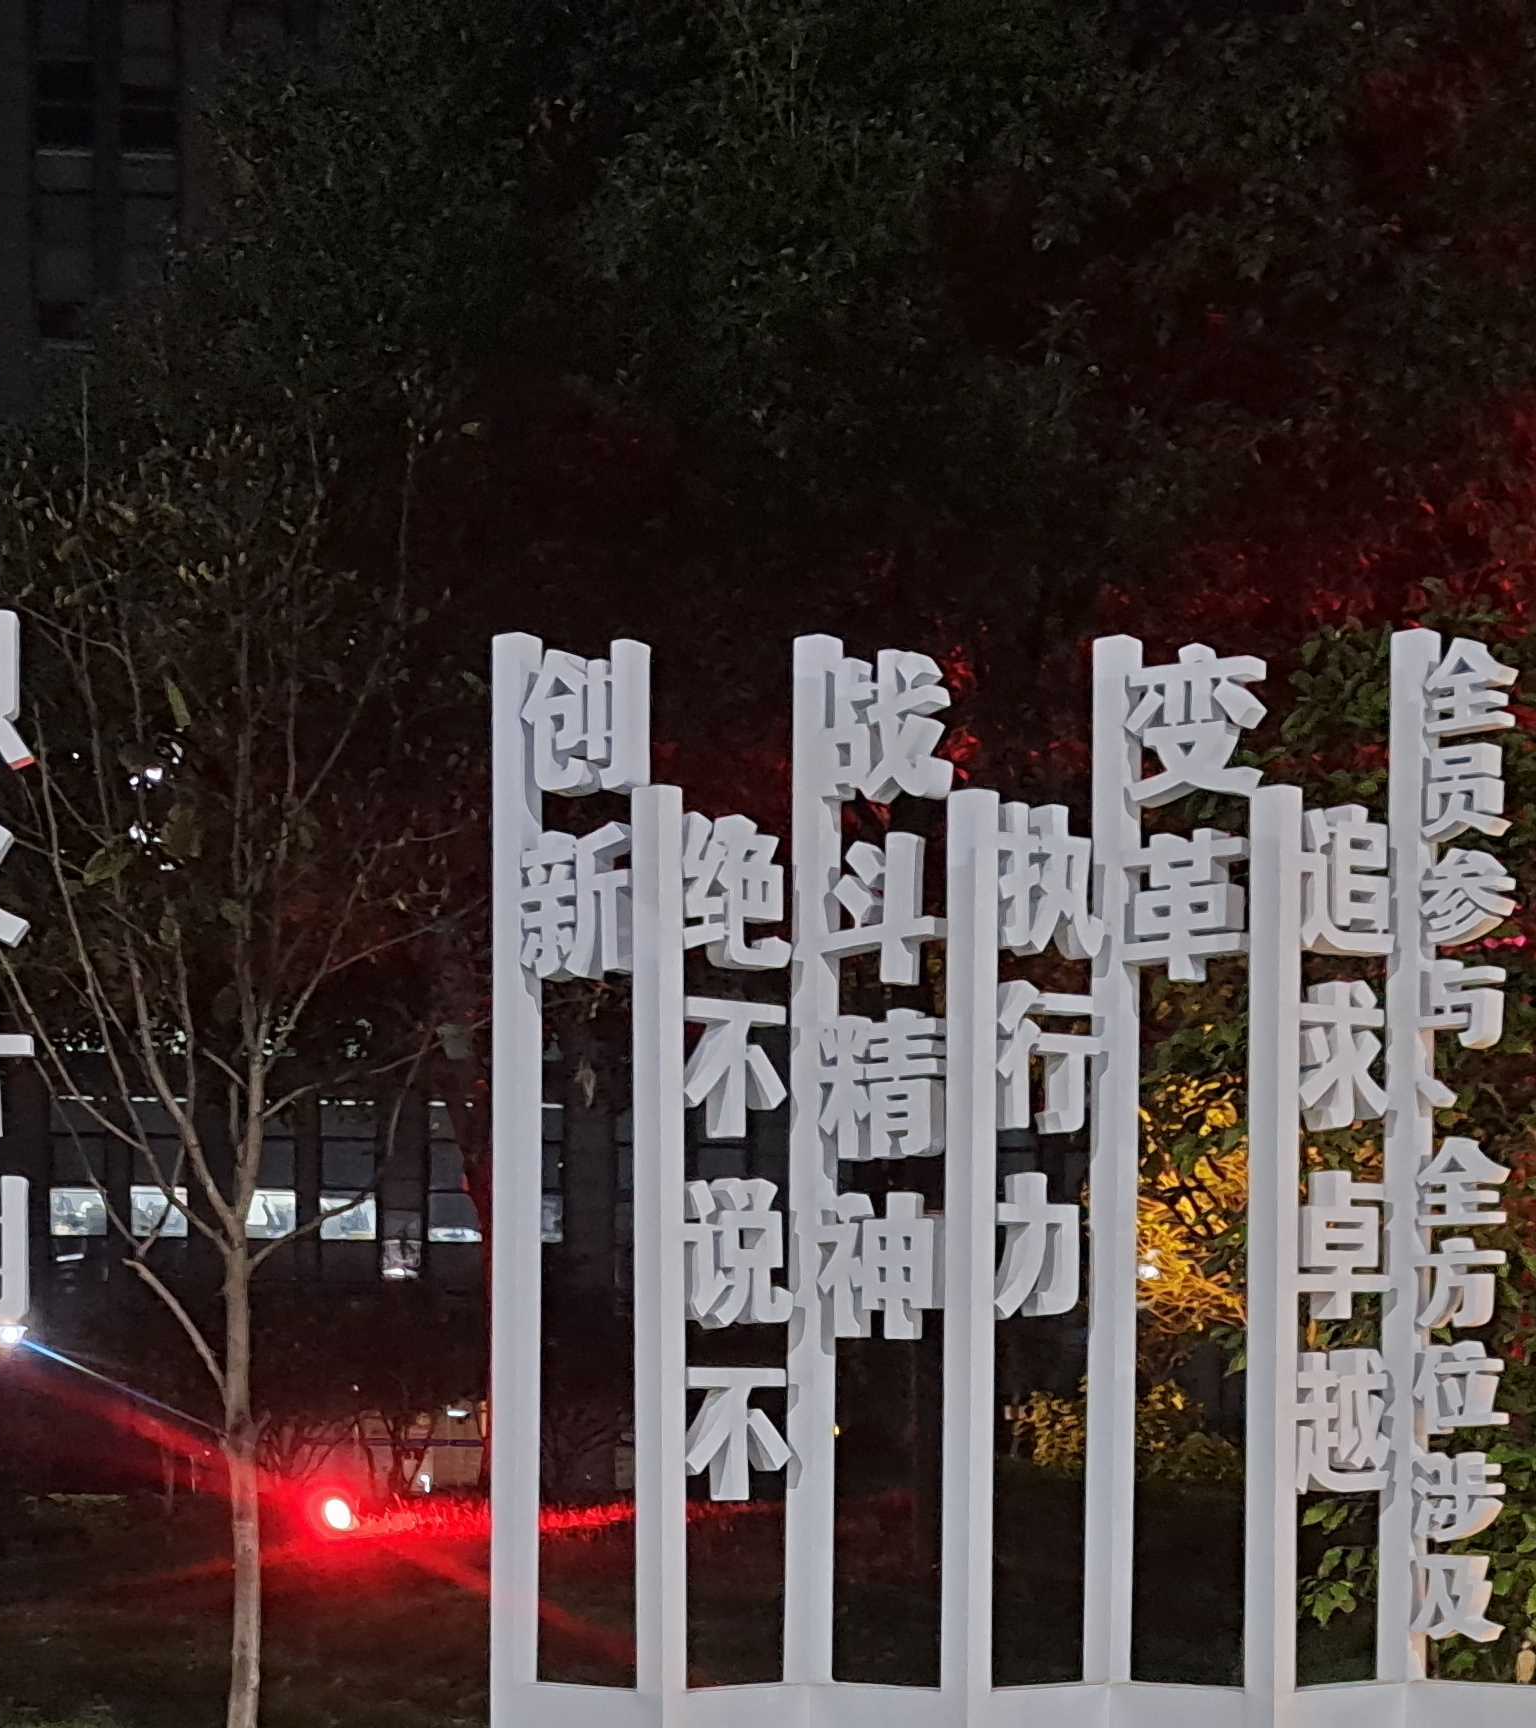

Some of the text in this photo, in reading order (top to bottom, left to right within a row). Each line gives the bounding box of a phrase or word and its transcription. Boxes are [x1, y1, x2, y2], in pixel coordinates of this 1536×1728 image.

[517, 646, 652, 982] 创新
[680, 812, 798, 1502] 绝不说不
[816, 648, 954, 1340] 战斗精神
[1124, 642, 1268, 982] 变革
[1296, 800, 1396, 1496] 追求卓越
